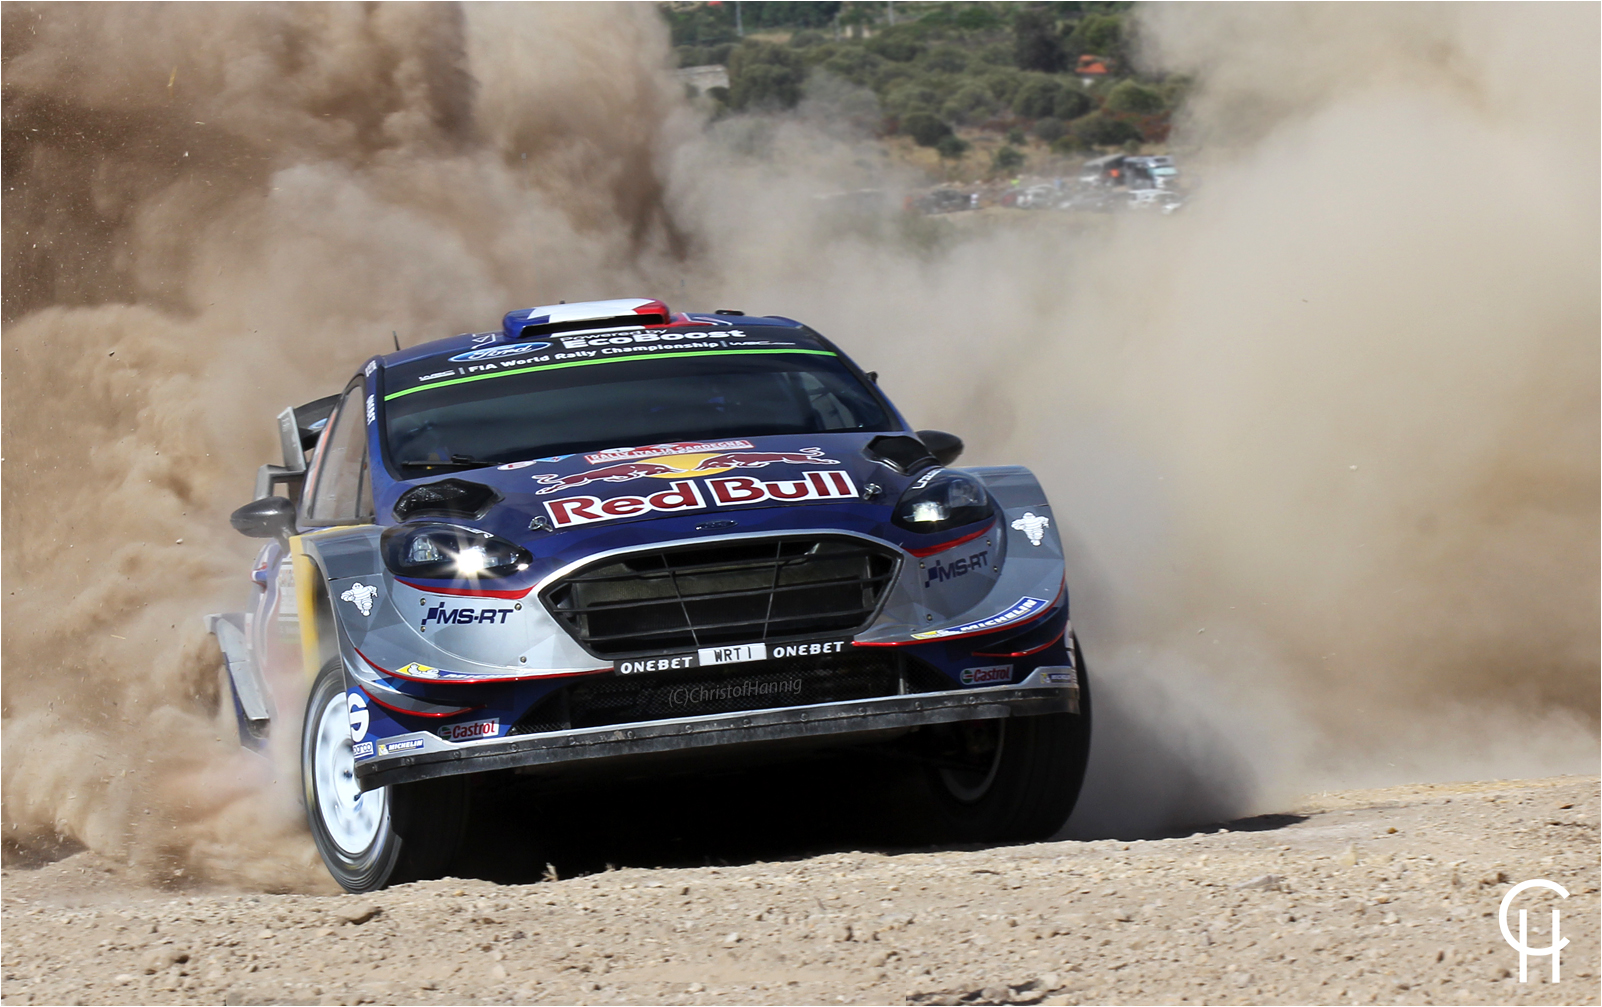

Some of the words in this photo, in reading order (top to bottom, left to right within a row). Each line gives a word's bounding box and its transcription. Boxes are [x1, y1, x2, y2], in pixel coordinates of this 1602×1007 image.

[560, 330, 642, 342] Powered
[644, 328, 667, 336] by
[562, 329, 746, 349] EcoBoost
[468, 345, 532, 360] Ford
[468, 363, 498, 373] FIA
[500, 355, 550, 367] World
[554, 348, 597, 360] Rally
[601, 341, 719, 355] Championship
[591, 450, 630, 462] RALLY
[632, 447, 674, 457] ITALIA
[680, 441, 743, 451] SARDEGNA
[547, 481, 702, 526] Red
[707, 472, 855, 505] Bull
[937, 550, 989, 583] MS-RT
[436, 608, 514, 625] MS-RT
[960, 598, 1038, 631] MICHELIN
[713, 648, 741, 662] WRT
[773, 641, 845, 659] ONEBET
[620, 656, 693, 675] ONEBET
[973, 666, 1010, 683] Castrol
[452, 720, 496, 739] Castrol
[388, 739, 423, 751] MICHELIN
